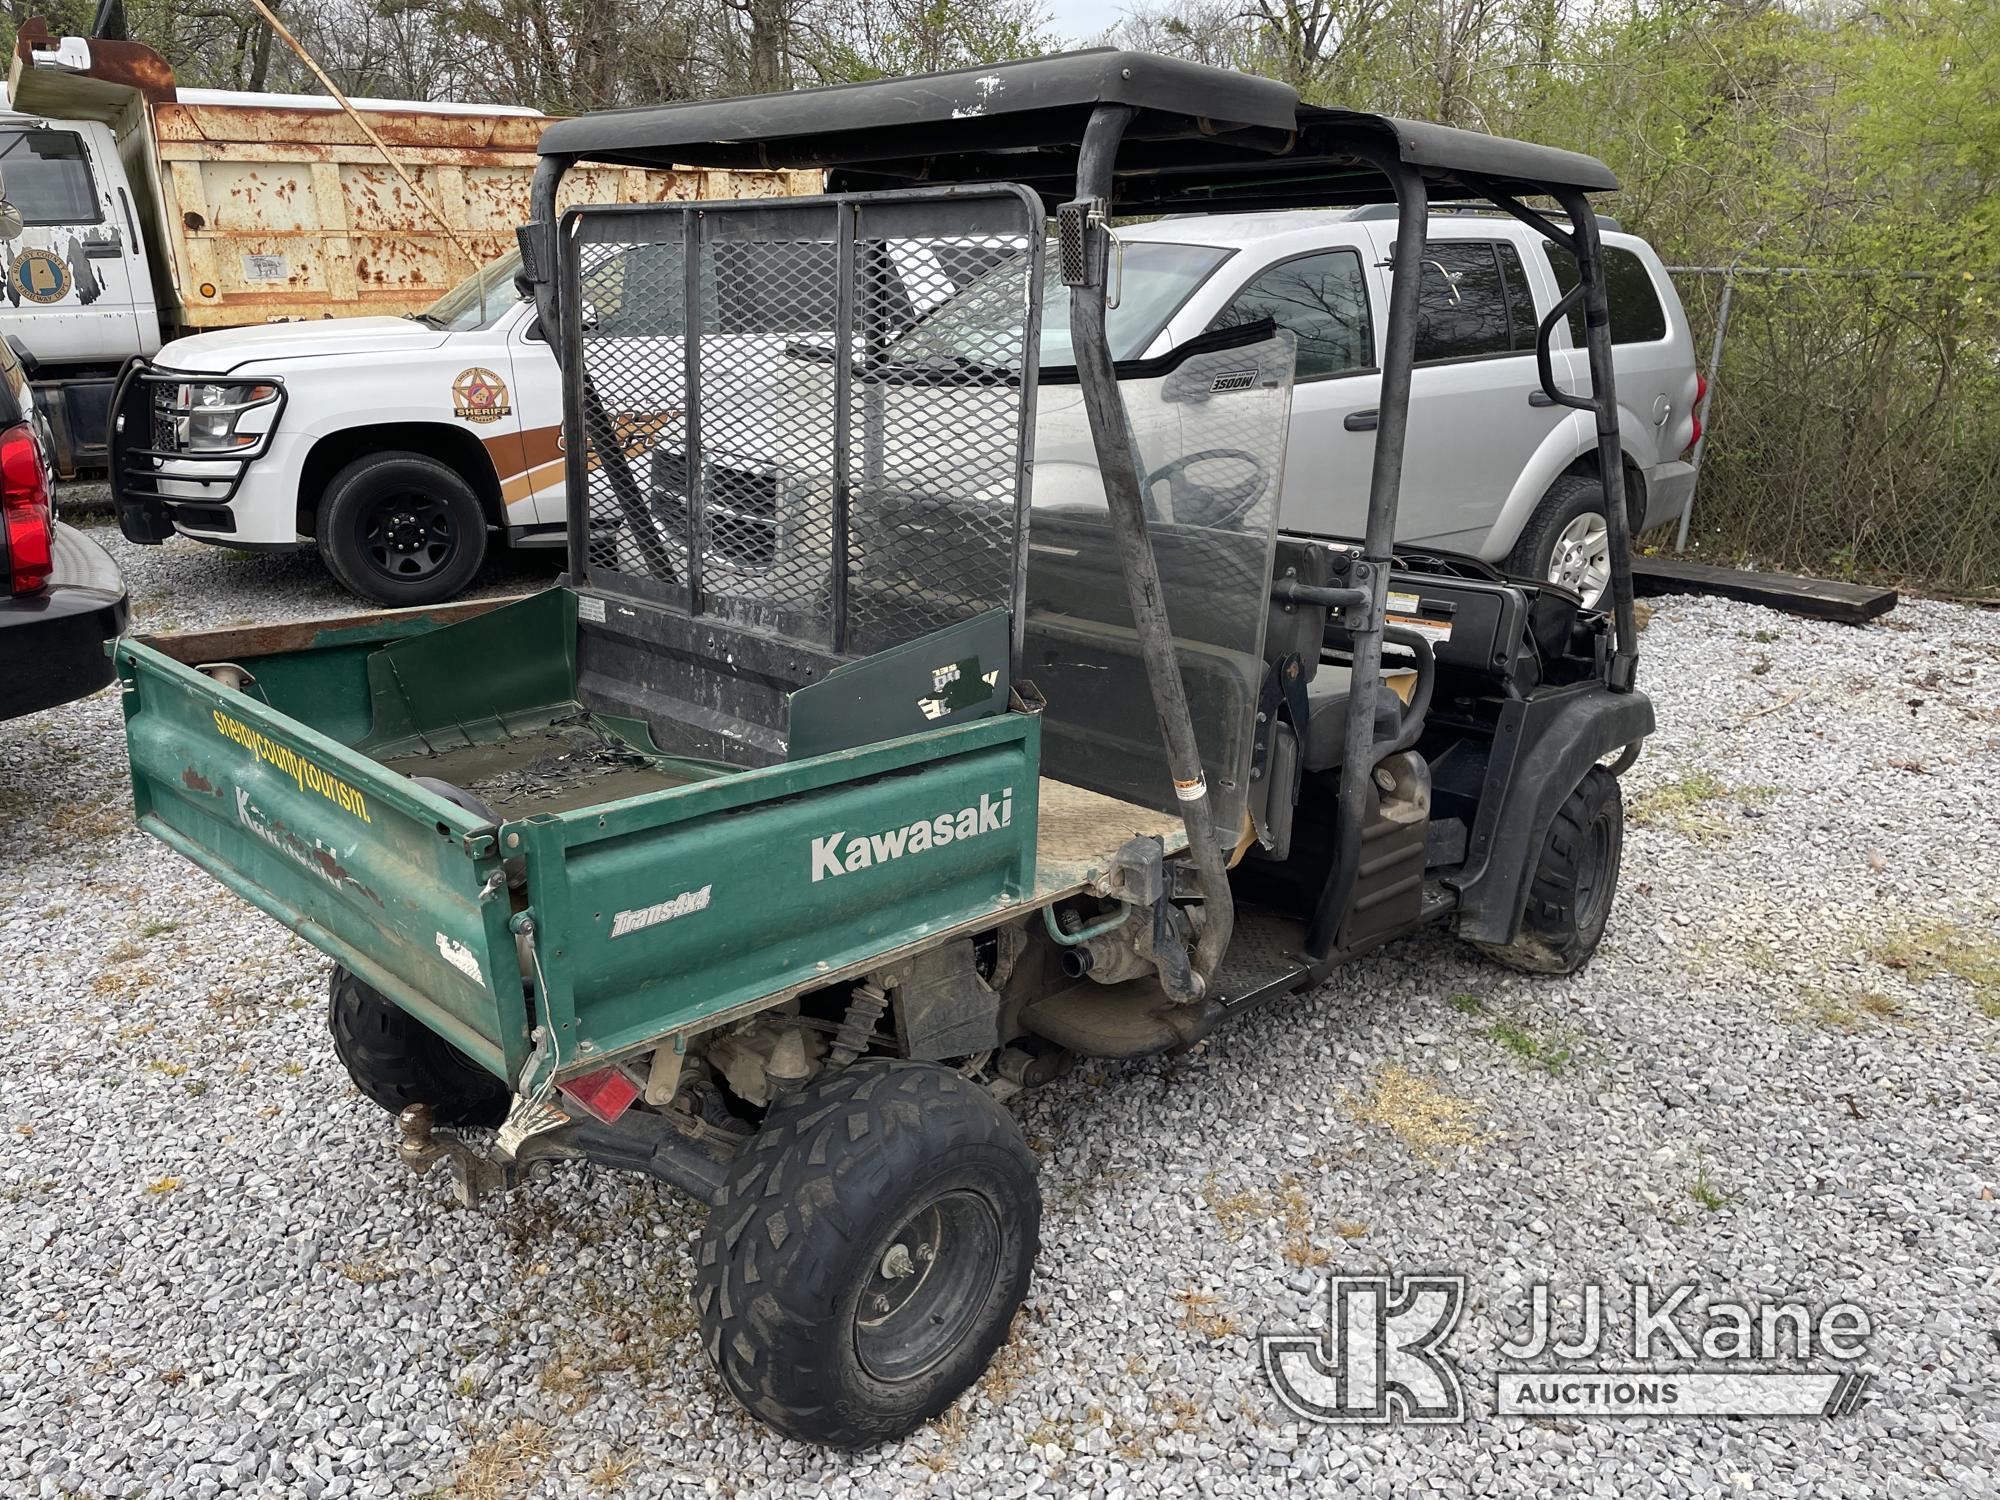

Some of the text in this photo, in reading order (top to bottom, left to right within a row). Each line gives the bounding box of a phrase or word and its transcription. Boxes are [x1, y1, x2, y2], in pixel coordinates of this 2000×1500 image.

[13, 252, 66, 274] SHELBY COUNTY
[18, 284, 52, 302] HIGHWAY
[1212, 376, 1254, 391] MOOSE
[457, 408, 509, 416] SHERIFF
[811, 787, 1012, 883] Kawasaki
[611, 884, 712, 938] Trans4x4
